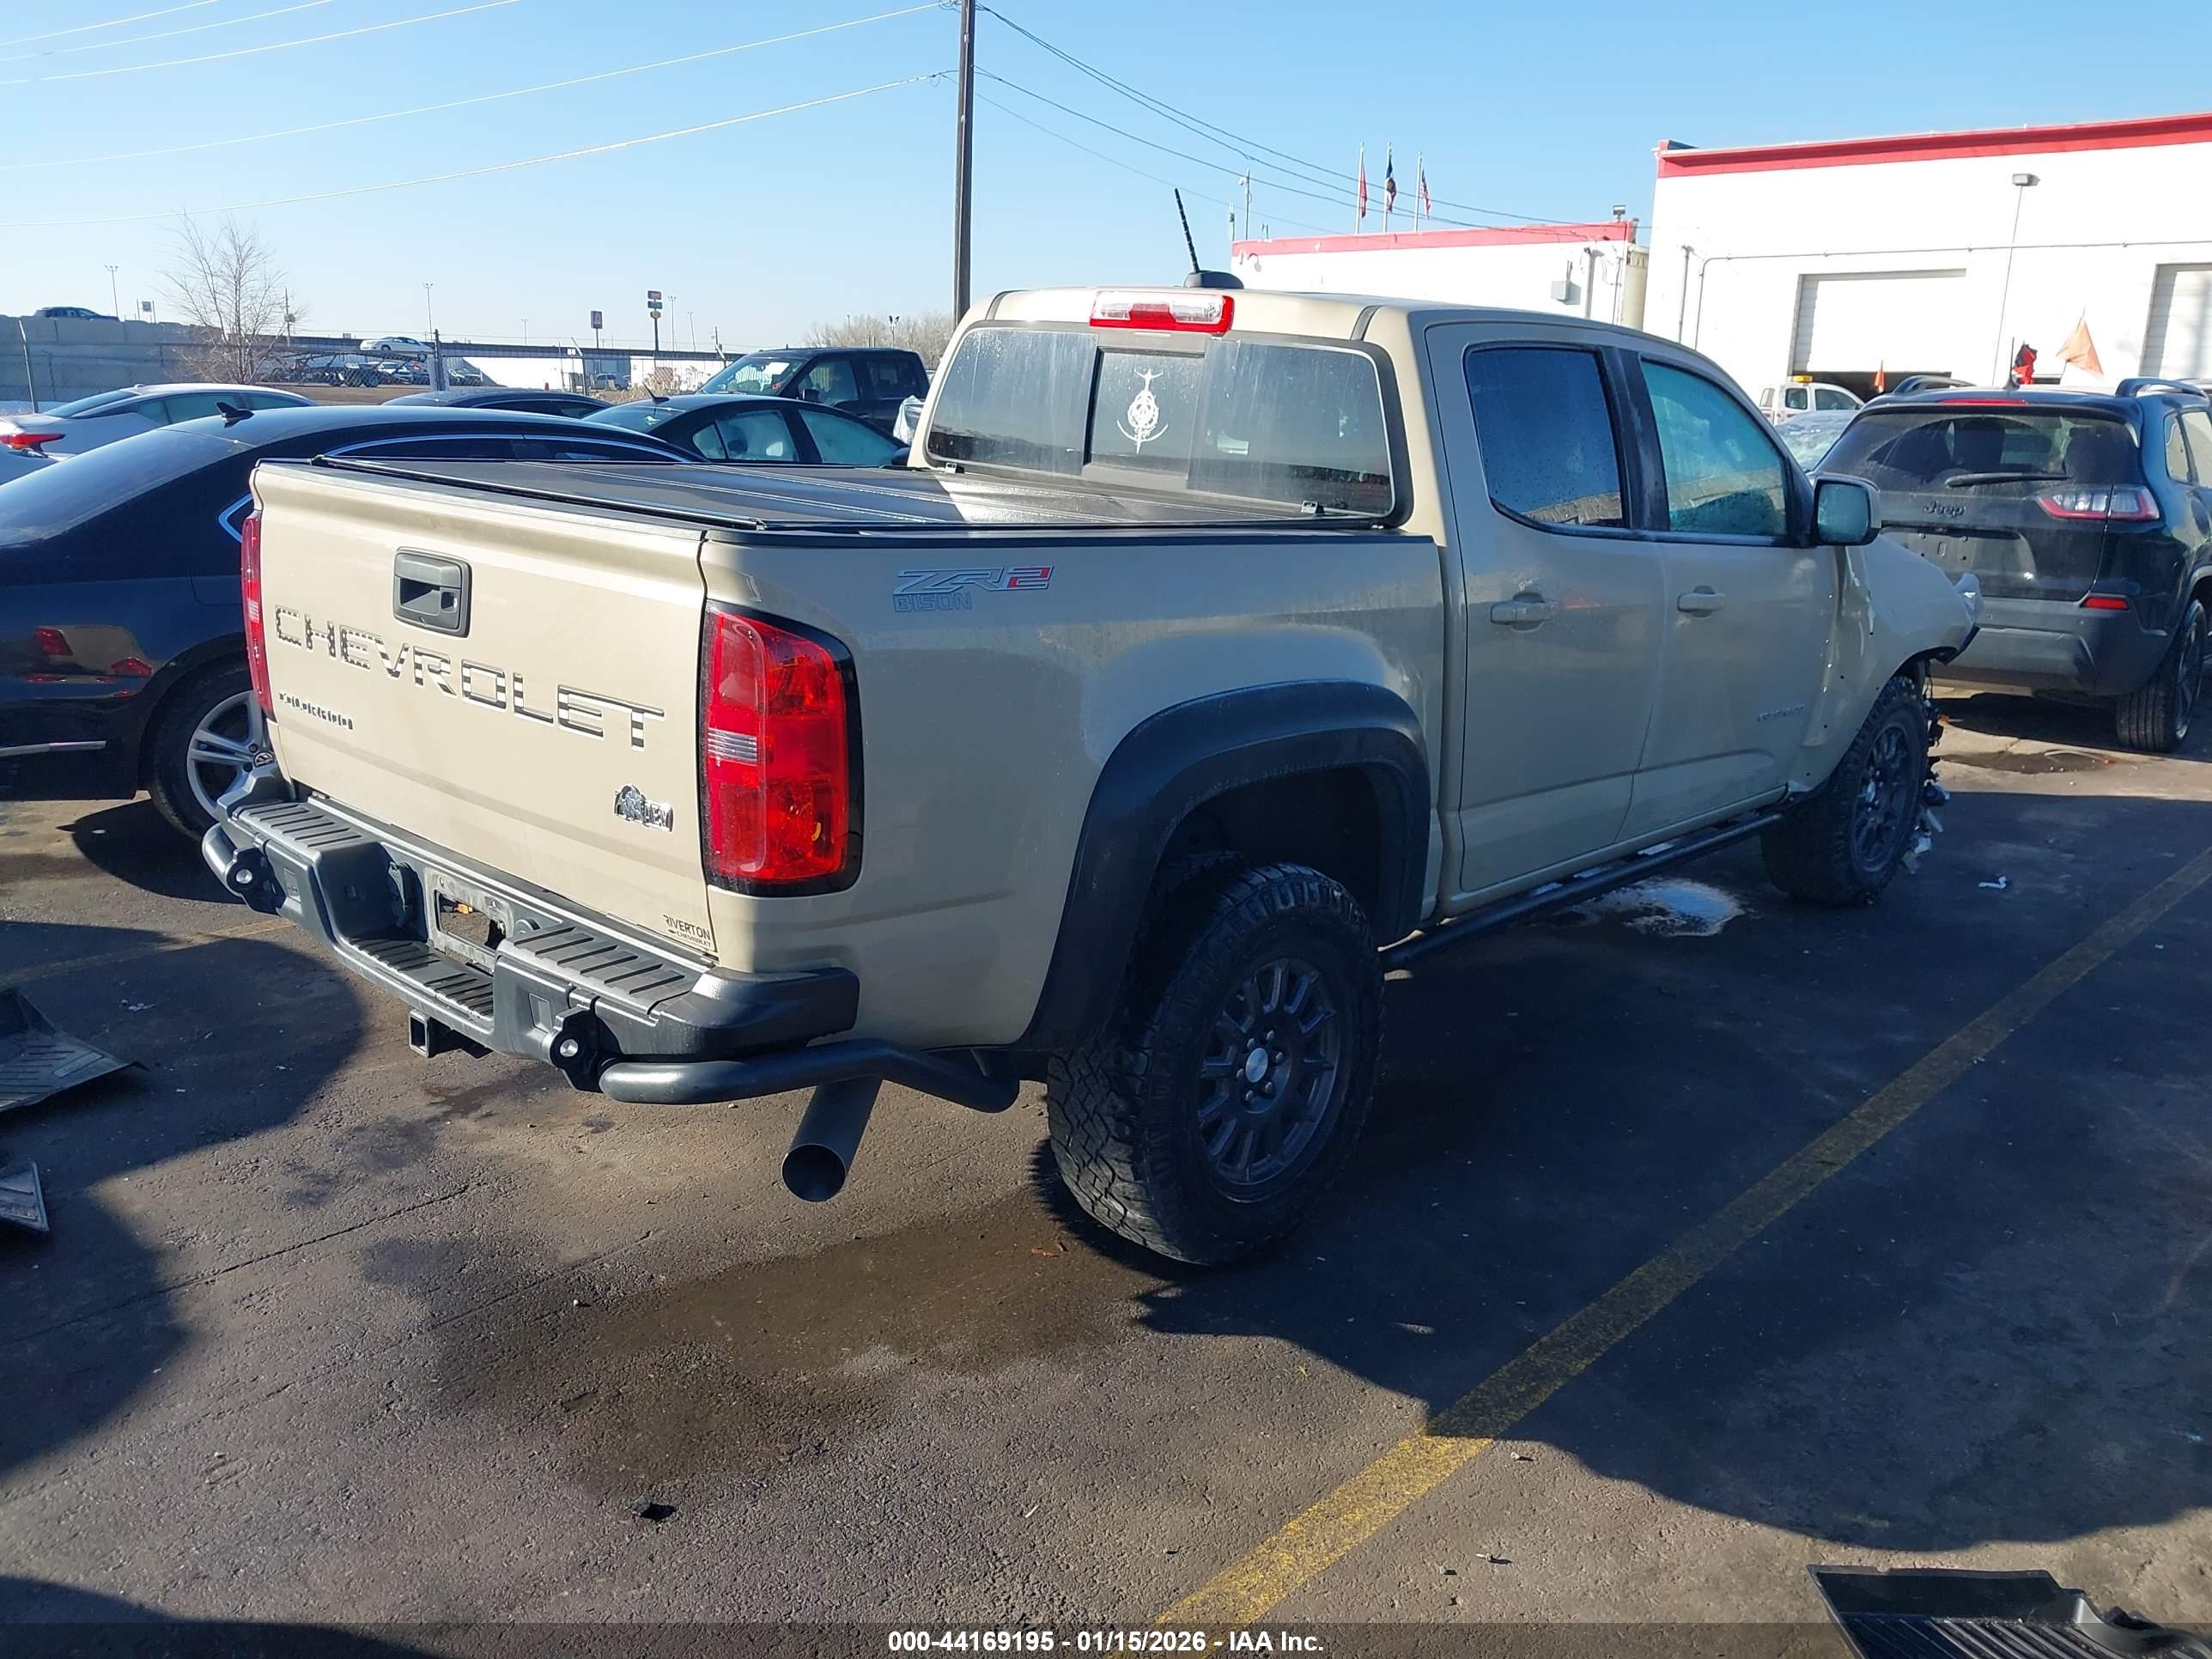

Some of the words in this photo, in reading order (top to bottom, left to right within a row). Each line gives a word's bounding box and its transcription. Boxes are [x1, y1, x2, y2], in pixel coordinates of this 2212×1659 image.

[1923, 500, 1966, 520] Jeep
[893, 566, 1054, 595] ZR2
[893, 592, 974, 613] BISON
[275, 605, 665, 750] CHEVROLET
[663, 915, 711, 941] RIVERTON
